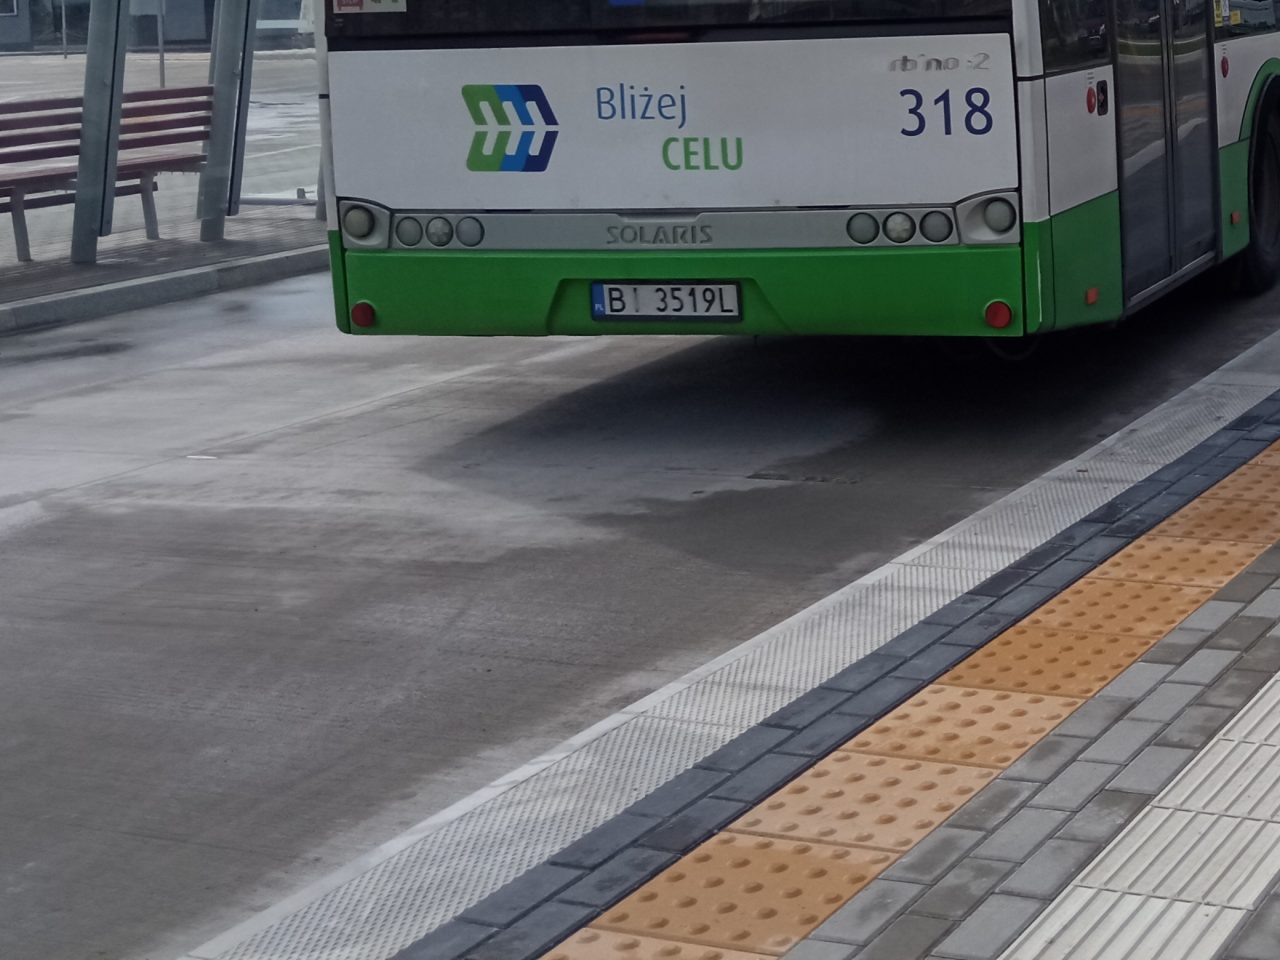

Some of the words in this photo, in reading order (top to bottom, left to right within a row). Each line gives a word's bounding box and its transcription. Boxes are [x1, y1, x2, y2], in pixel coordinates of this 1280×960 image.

[596, 83, 687, 130] Bliżej
[899, 86, 994, 137] 318
[661, 136, 744, 171] CELU
[606, 225, 714, 245] SOLARIS
[655, 286, 735, 314] 3519L
